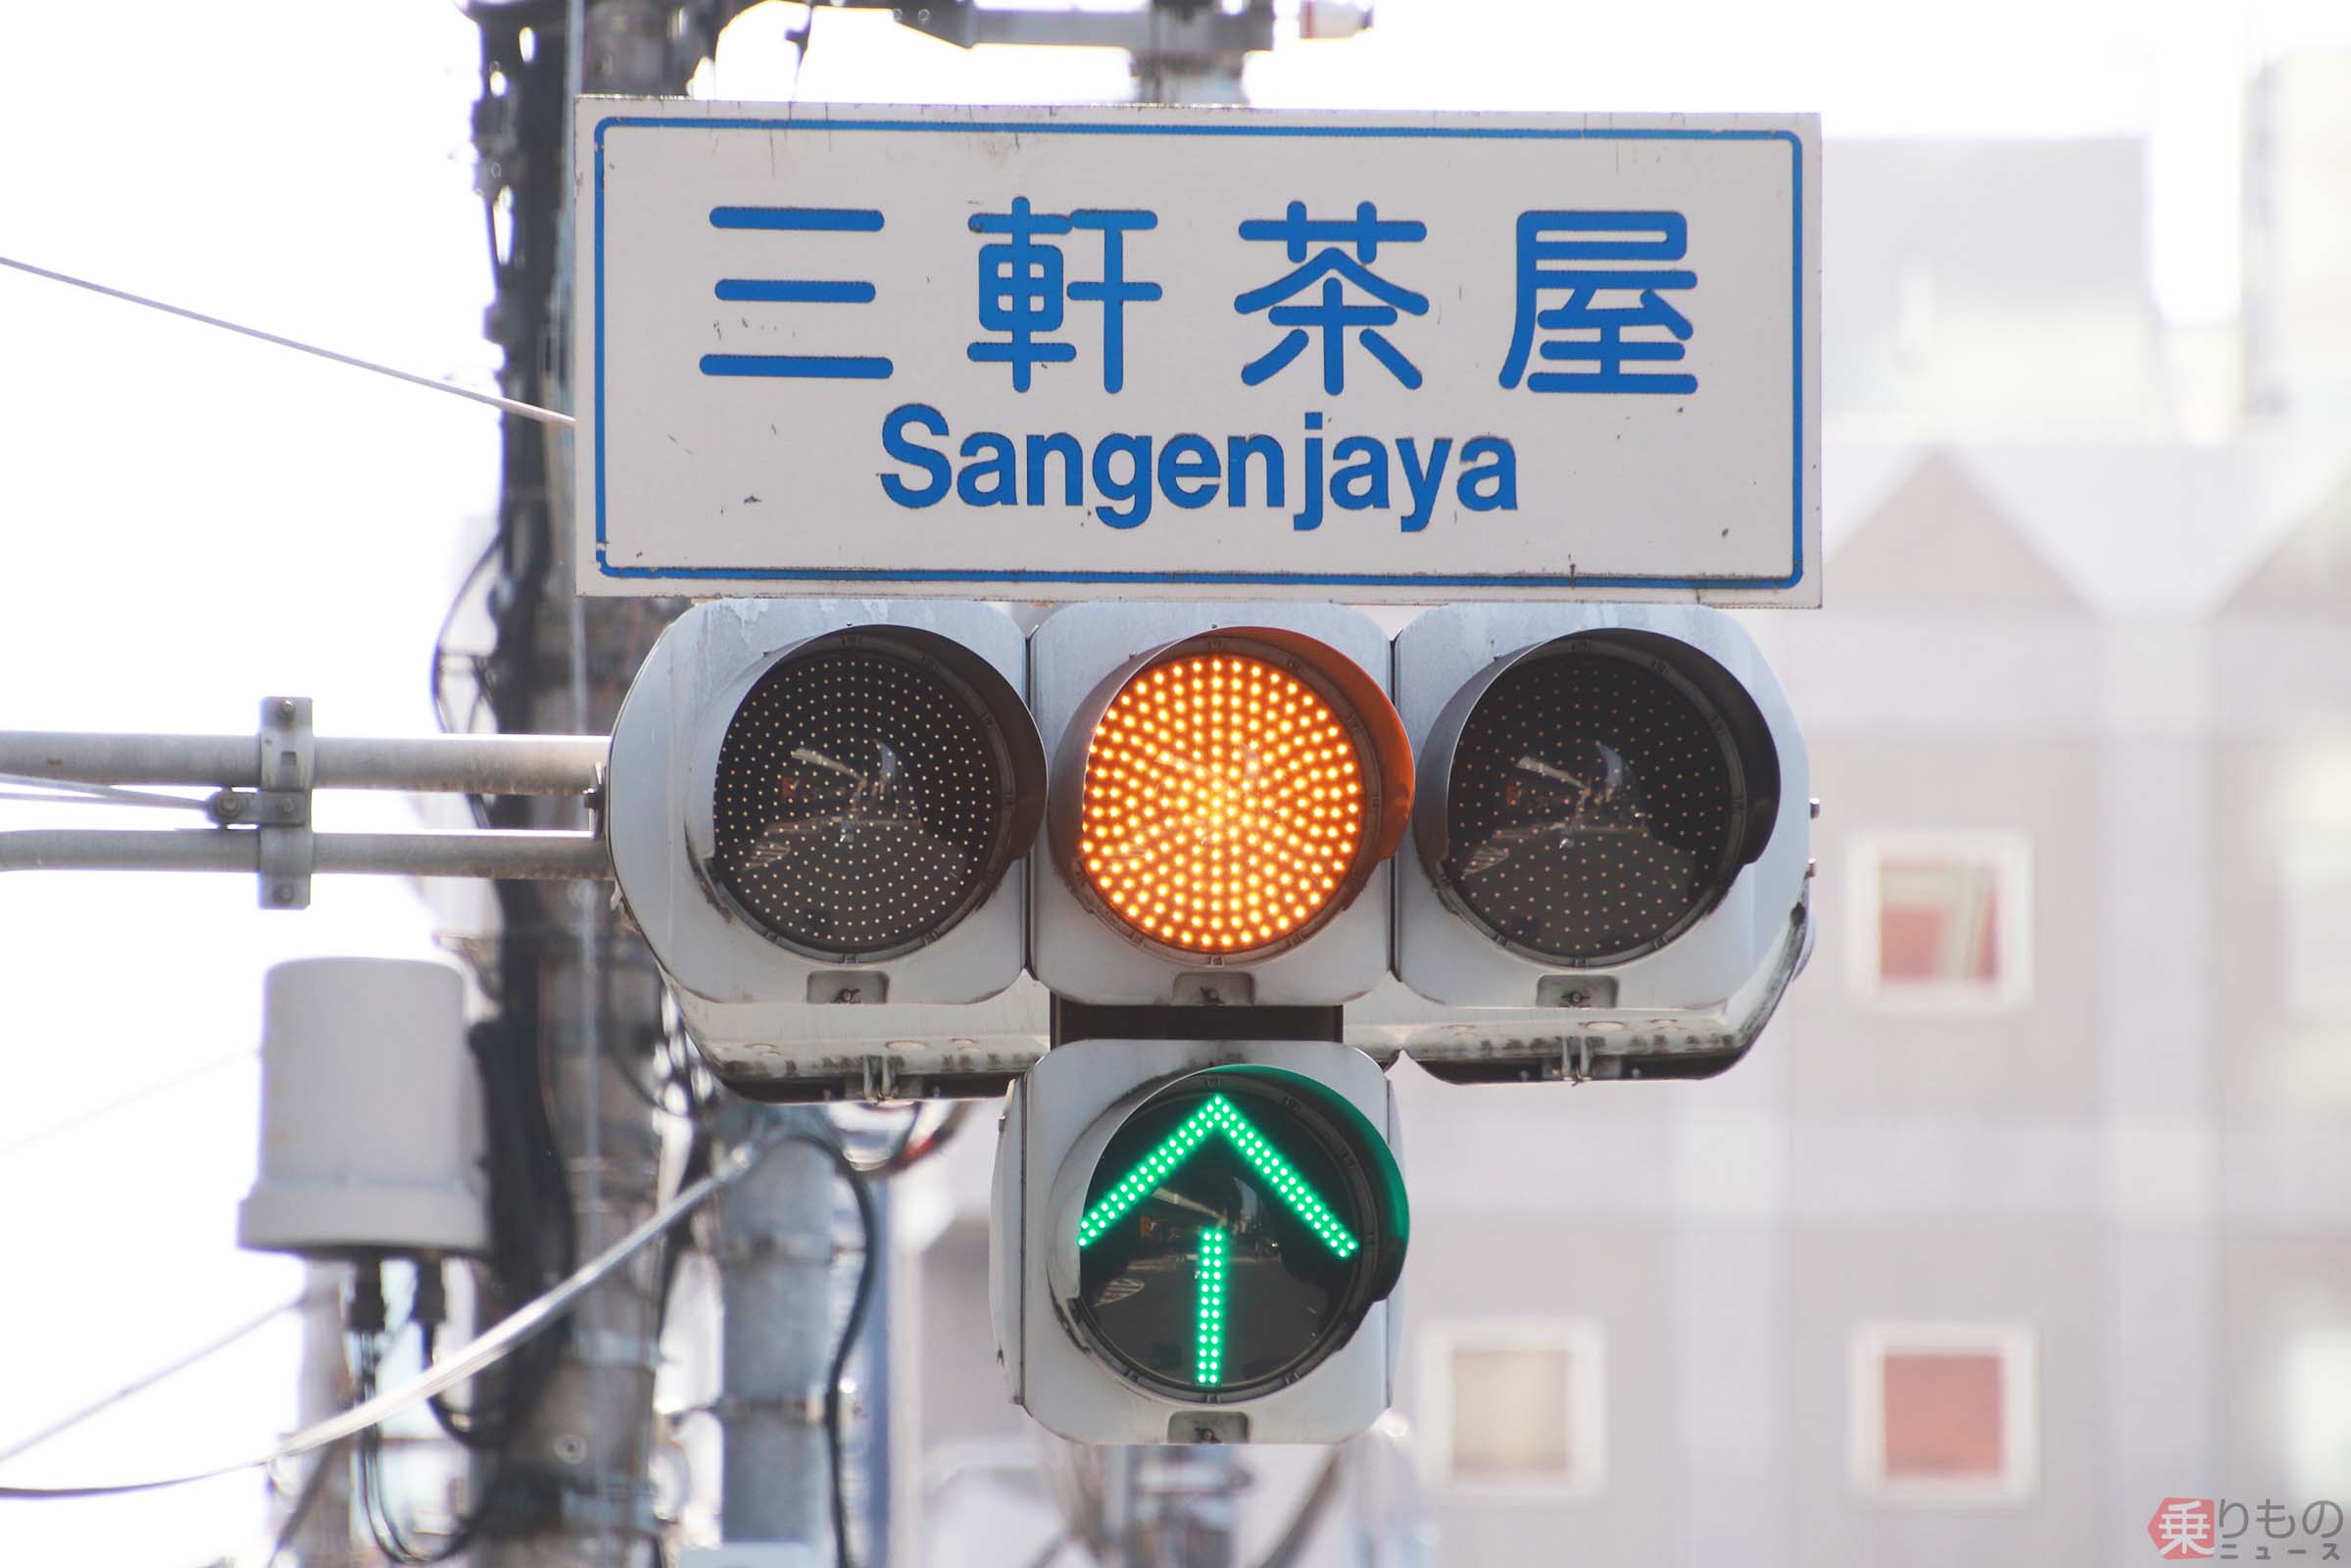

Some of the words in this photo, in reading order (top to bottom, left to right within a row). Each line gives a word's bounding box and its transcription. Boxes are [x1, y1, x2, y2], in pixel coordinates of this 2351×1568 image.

[699, 196, 1698, 395] 三軒茶屋
[880, 403, 1518, 533] Sangenjaya
